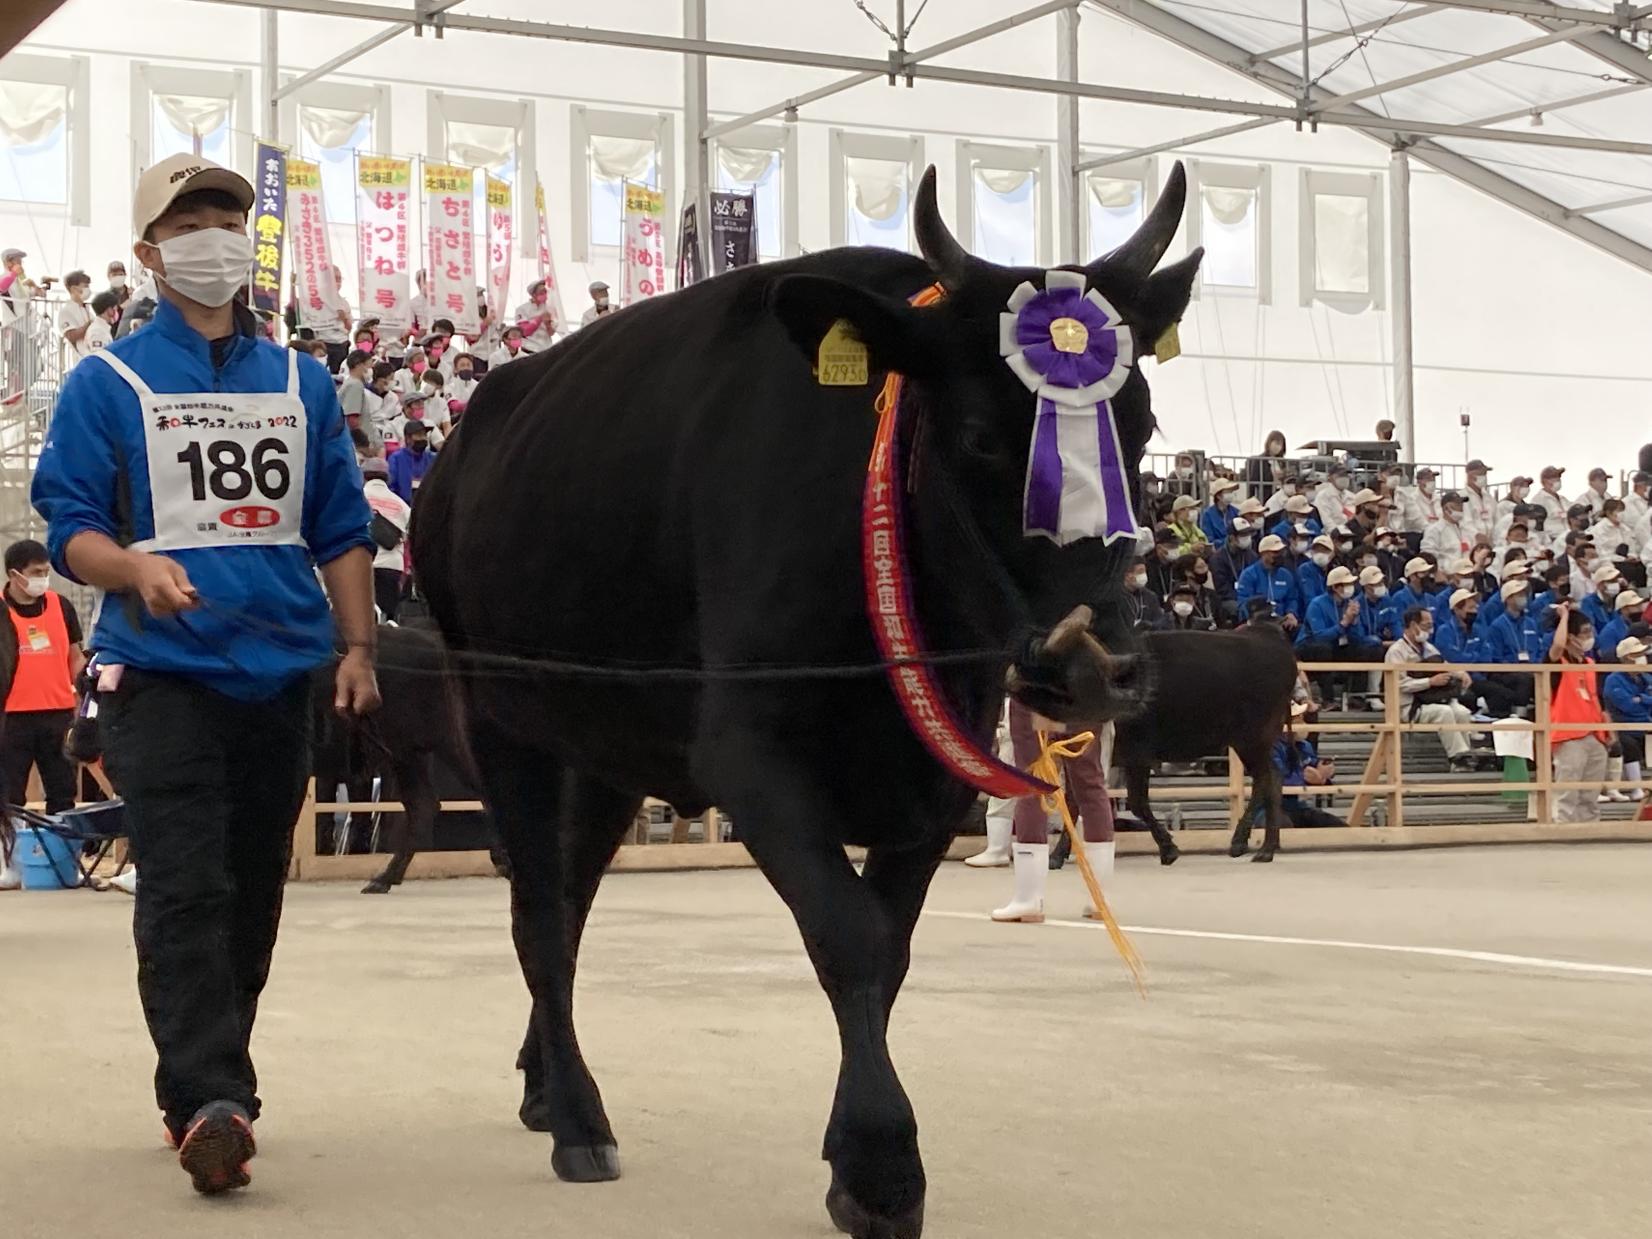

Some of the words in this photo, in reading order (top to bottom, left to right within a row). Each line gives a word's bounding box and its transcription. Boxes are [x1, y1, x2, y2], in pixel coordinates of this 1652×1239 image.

[359, 171, 393, 184] 北海道
[426, 177, 457, 190] 北海道
[626, 199, 652, 212] 北海道
[714, 199, 748, 216] 必勝
[255, 214, 282, 292] 豊後牛
[374, 191, 396, 308] はつね号
[442, 197, 465, 314] ちさと号
[637, 217, 655, 296] うめの
[268, 415, 298, 429] 2022
[177, 437, 291, 501] 186
